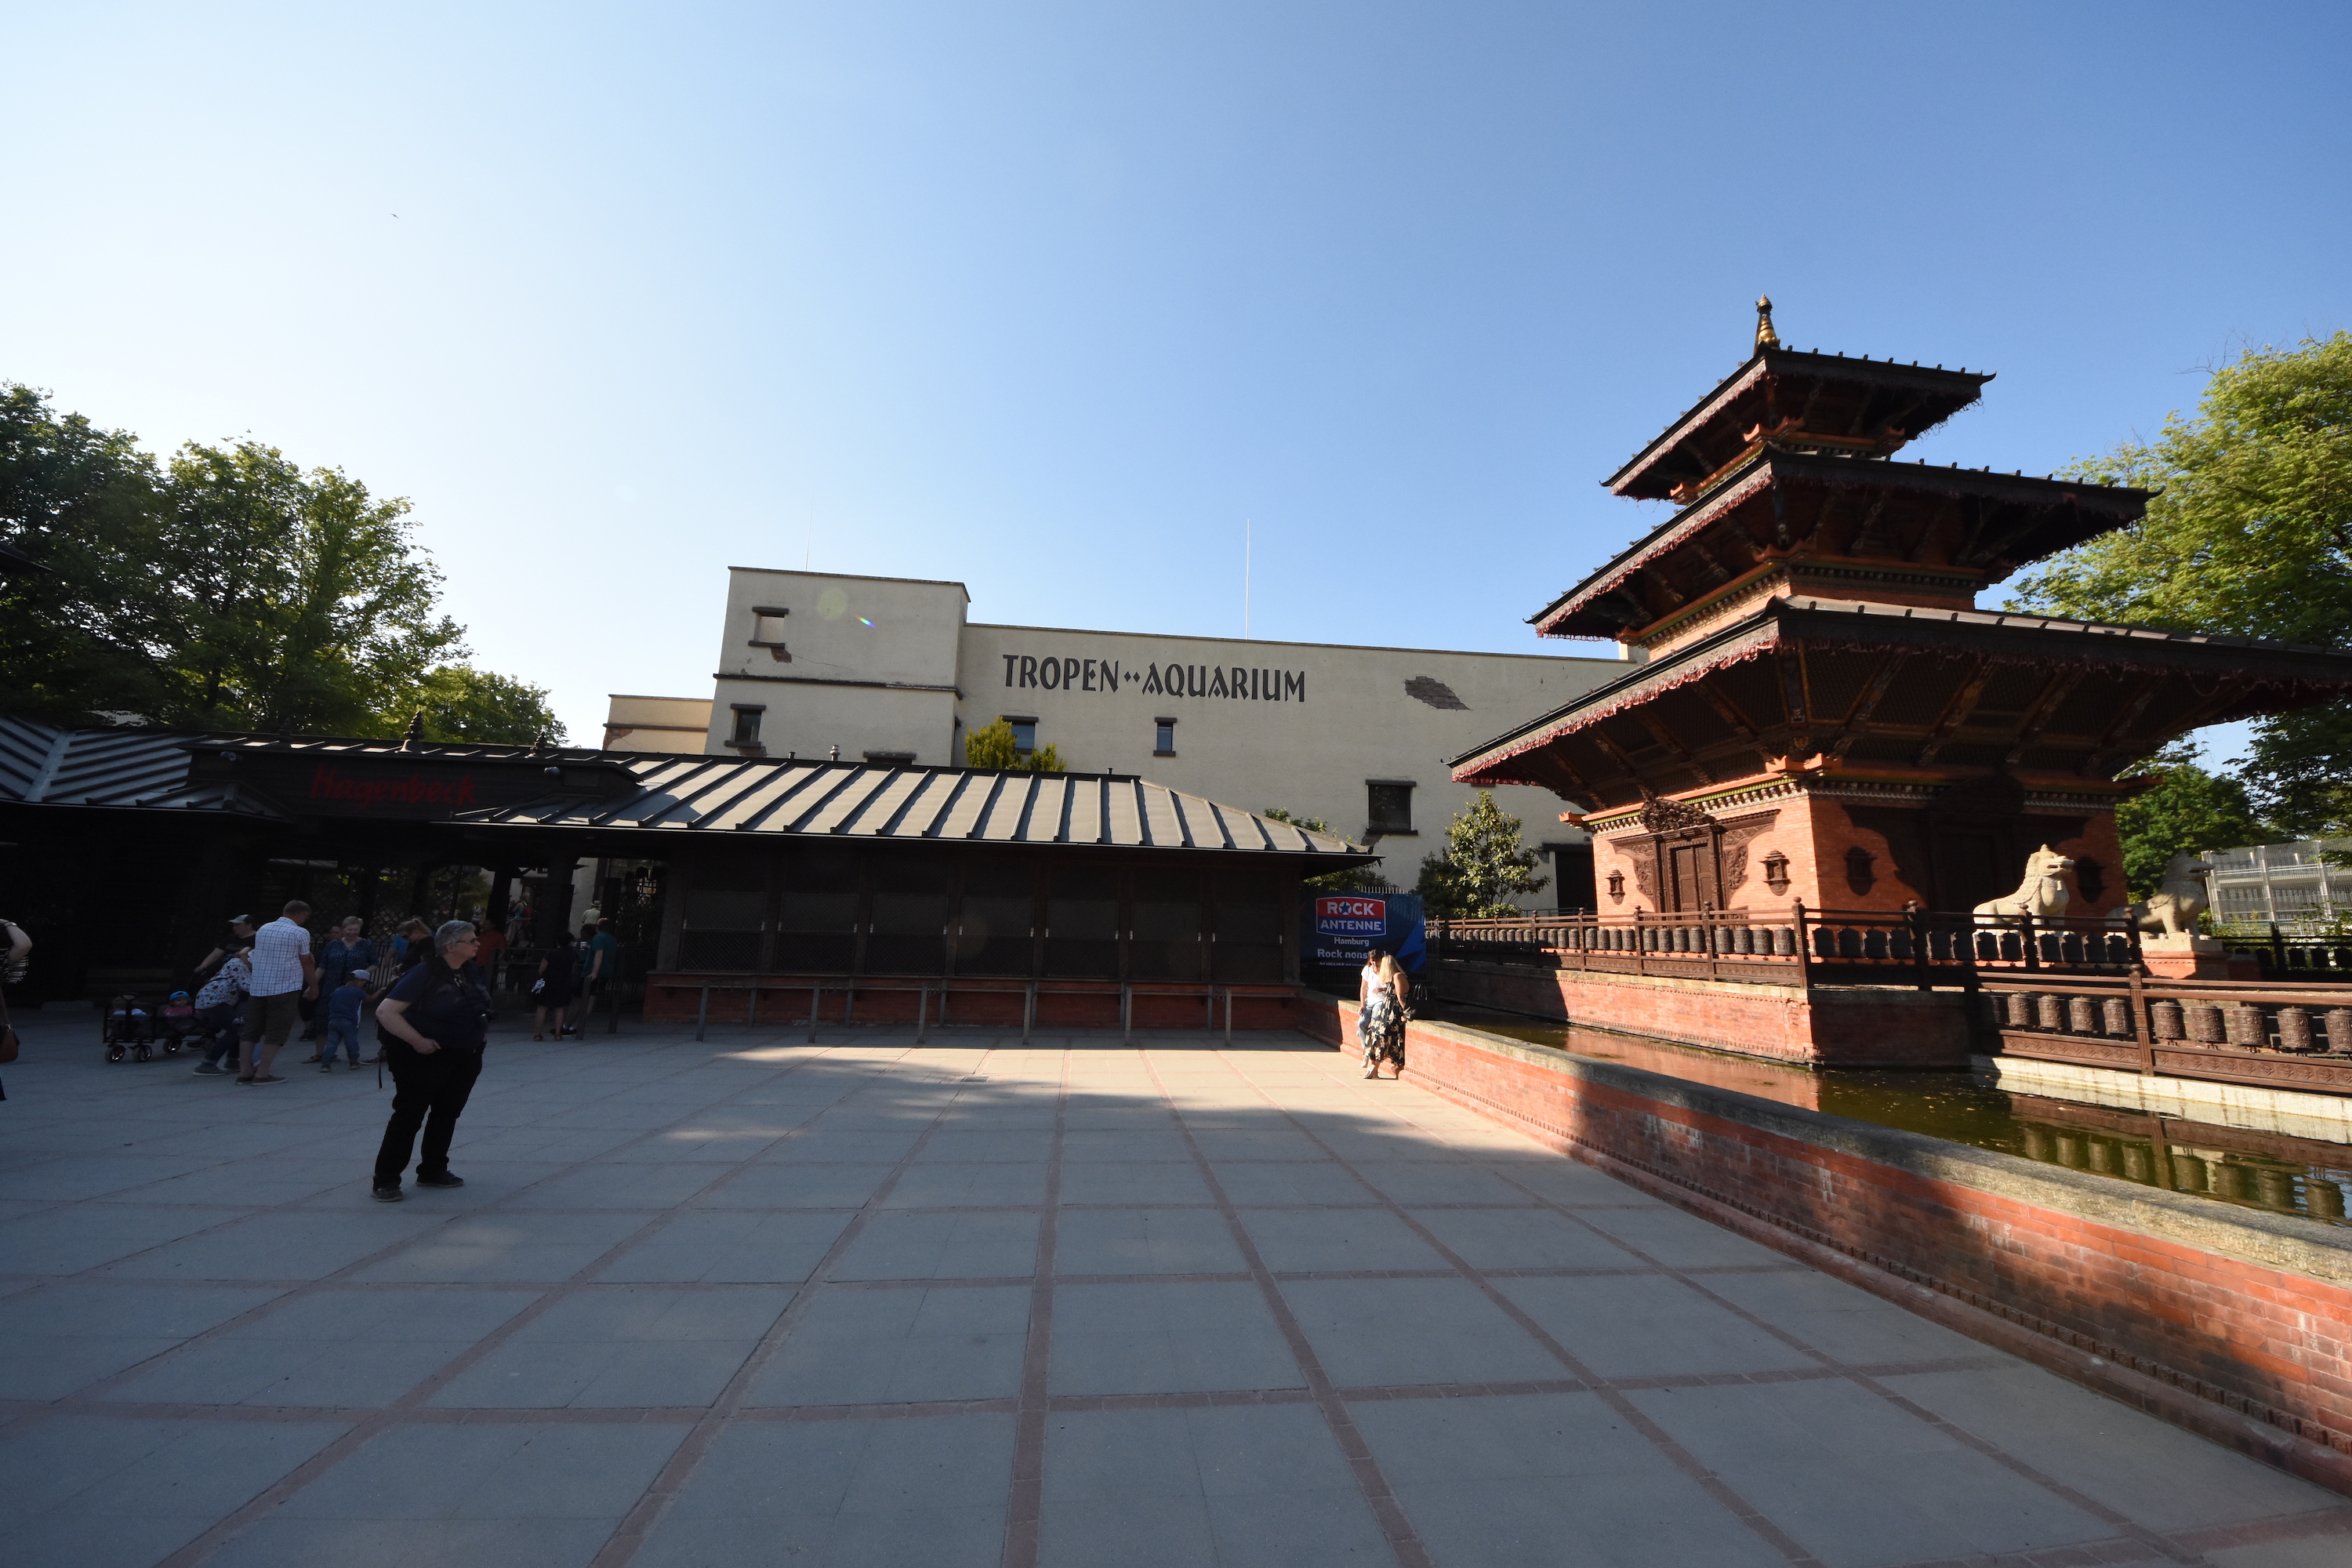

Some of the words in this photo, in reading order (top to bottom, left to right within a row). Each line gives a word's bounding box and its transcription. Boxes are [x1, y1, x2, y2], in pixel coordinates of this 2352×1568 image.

[1002, 654, 1119, 693] TROPEN
[1142, 661, 1305, 702] AQUARIUM
[310, 764, 477, 813] Hagenbeck
[1327, 901, 1375, 916] ROCK
[1320, 919, 1381, 931] ANTENNE
[1334, 936, 1370, 946] Hamburg
[1317, 948, 1343, 959] Rock
